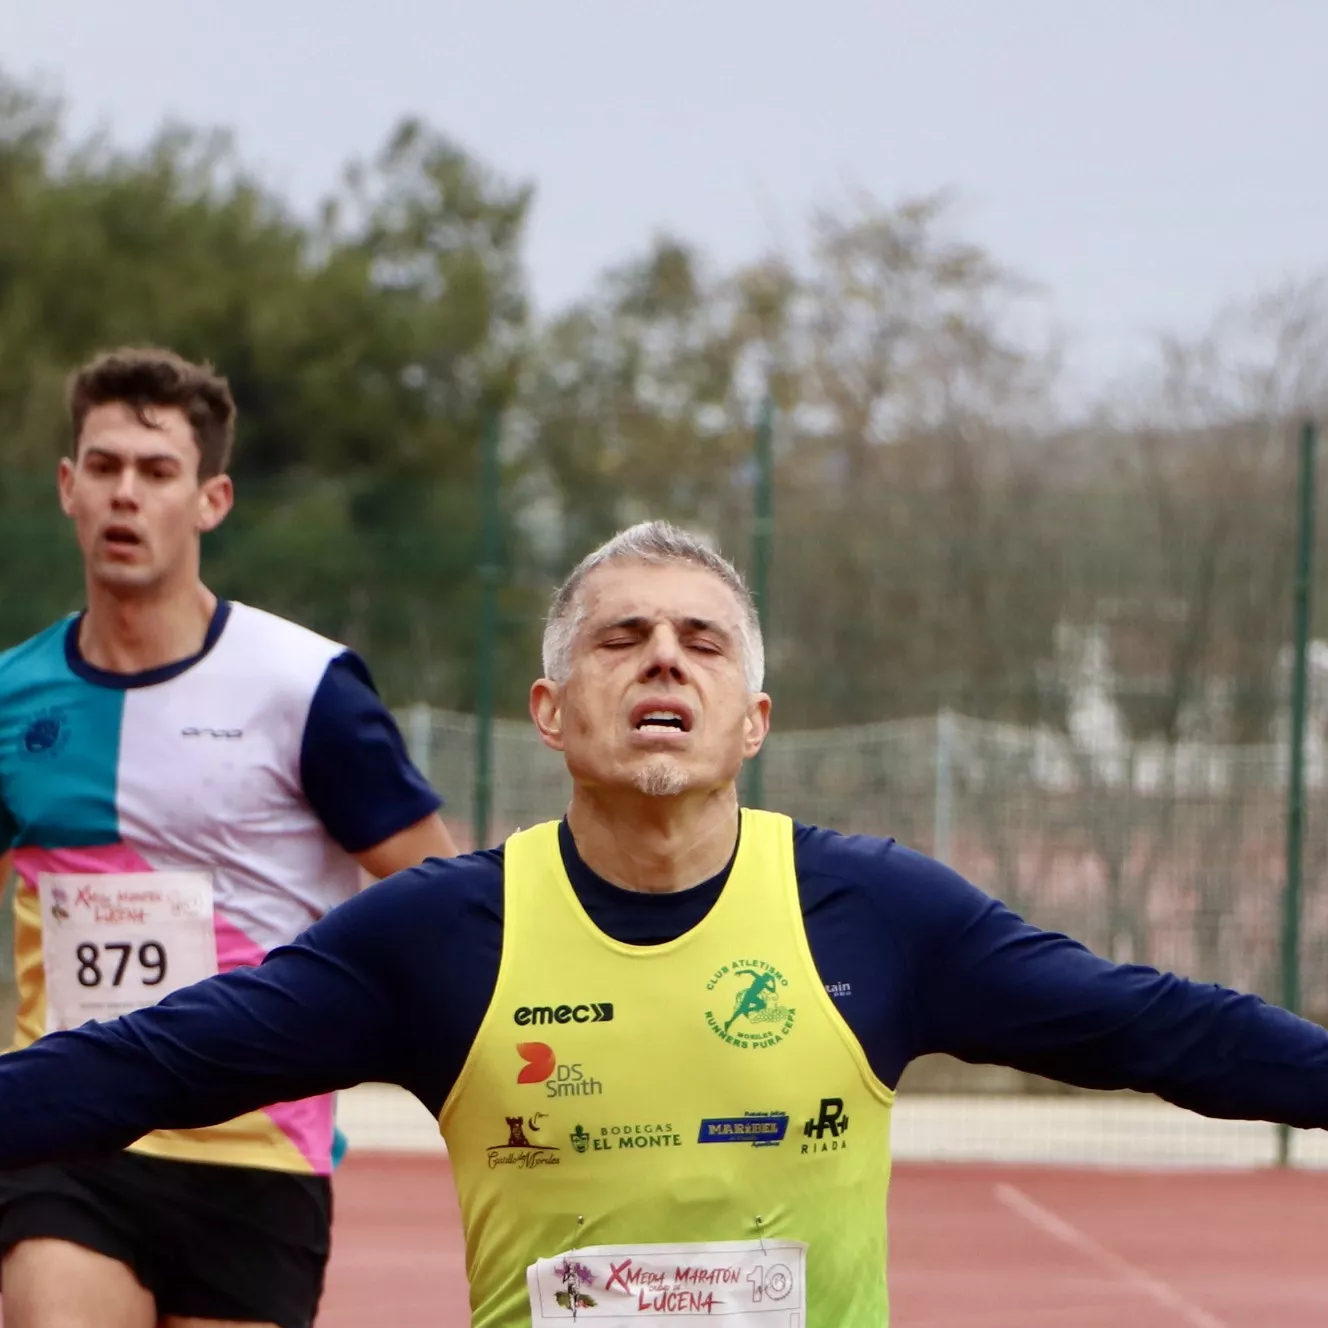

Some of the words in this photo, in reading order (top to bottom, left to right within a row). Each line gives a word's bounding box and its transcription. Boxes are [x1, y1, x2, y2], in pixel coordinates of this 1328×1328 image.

[76, 940, 168, 987] 879
[706, 966, 729, 991] CLUB
[732, 960, 789, 986] ATLETISMO
[513, 1004, 590, 1026] emec
[705, 1011, 749, 1049] RUNNERS
[753, 1034, 783, 1050] PURA
[781, 1007, 797, 1035] CEPA
[557, 1064, 584, 1081] DS
[546, 1077, 603, 1098] Smith
[601, 1124, 673, 1136] BODEGAS
[593, 1138, 612, 1151] EL
[619, 1134, 683, 1149] MONTE
[801, 1140, 847, 1154] RIADA
[605, 1258, 633, 1296] X
[675, 1266, 742, 1285] MARATÓN
[637, 1288, 725, 1314] LUCENA
